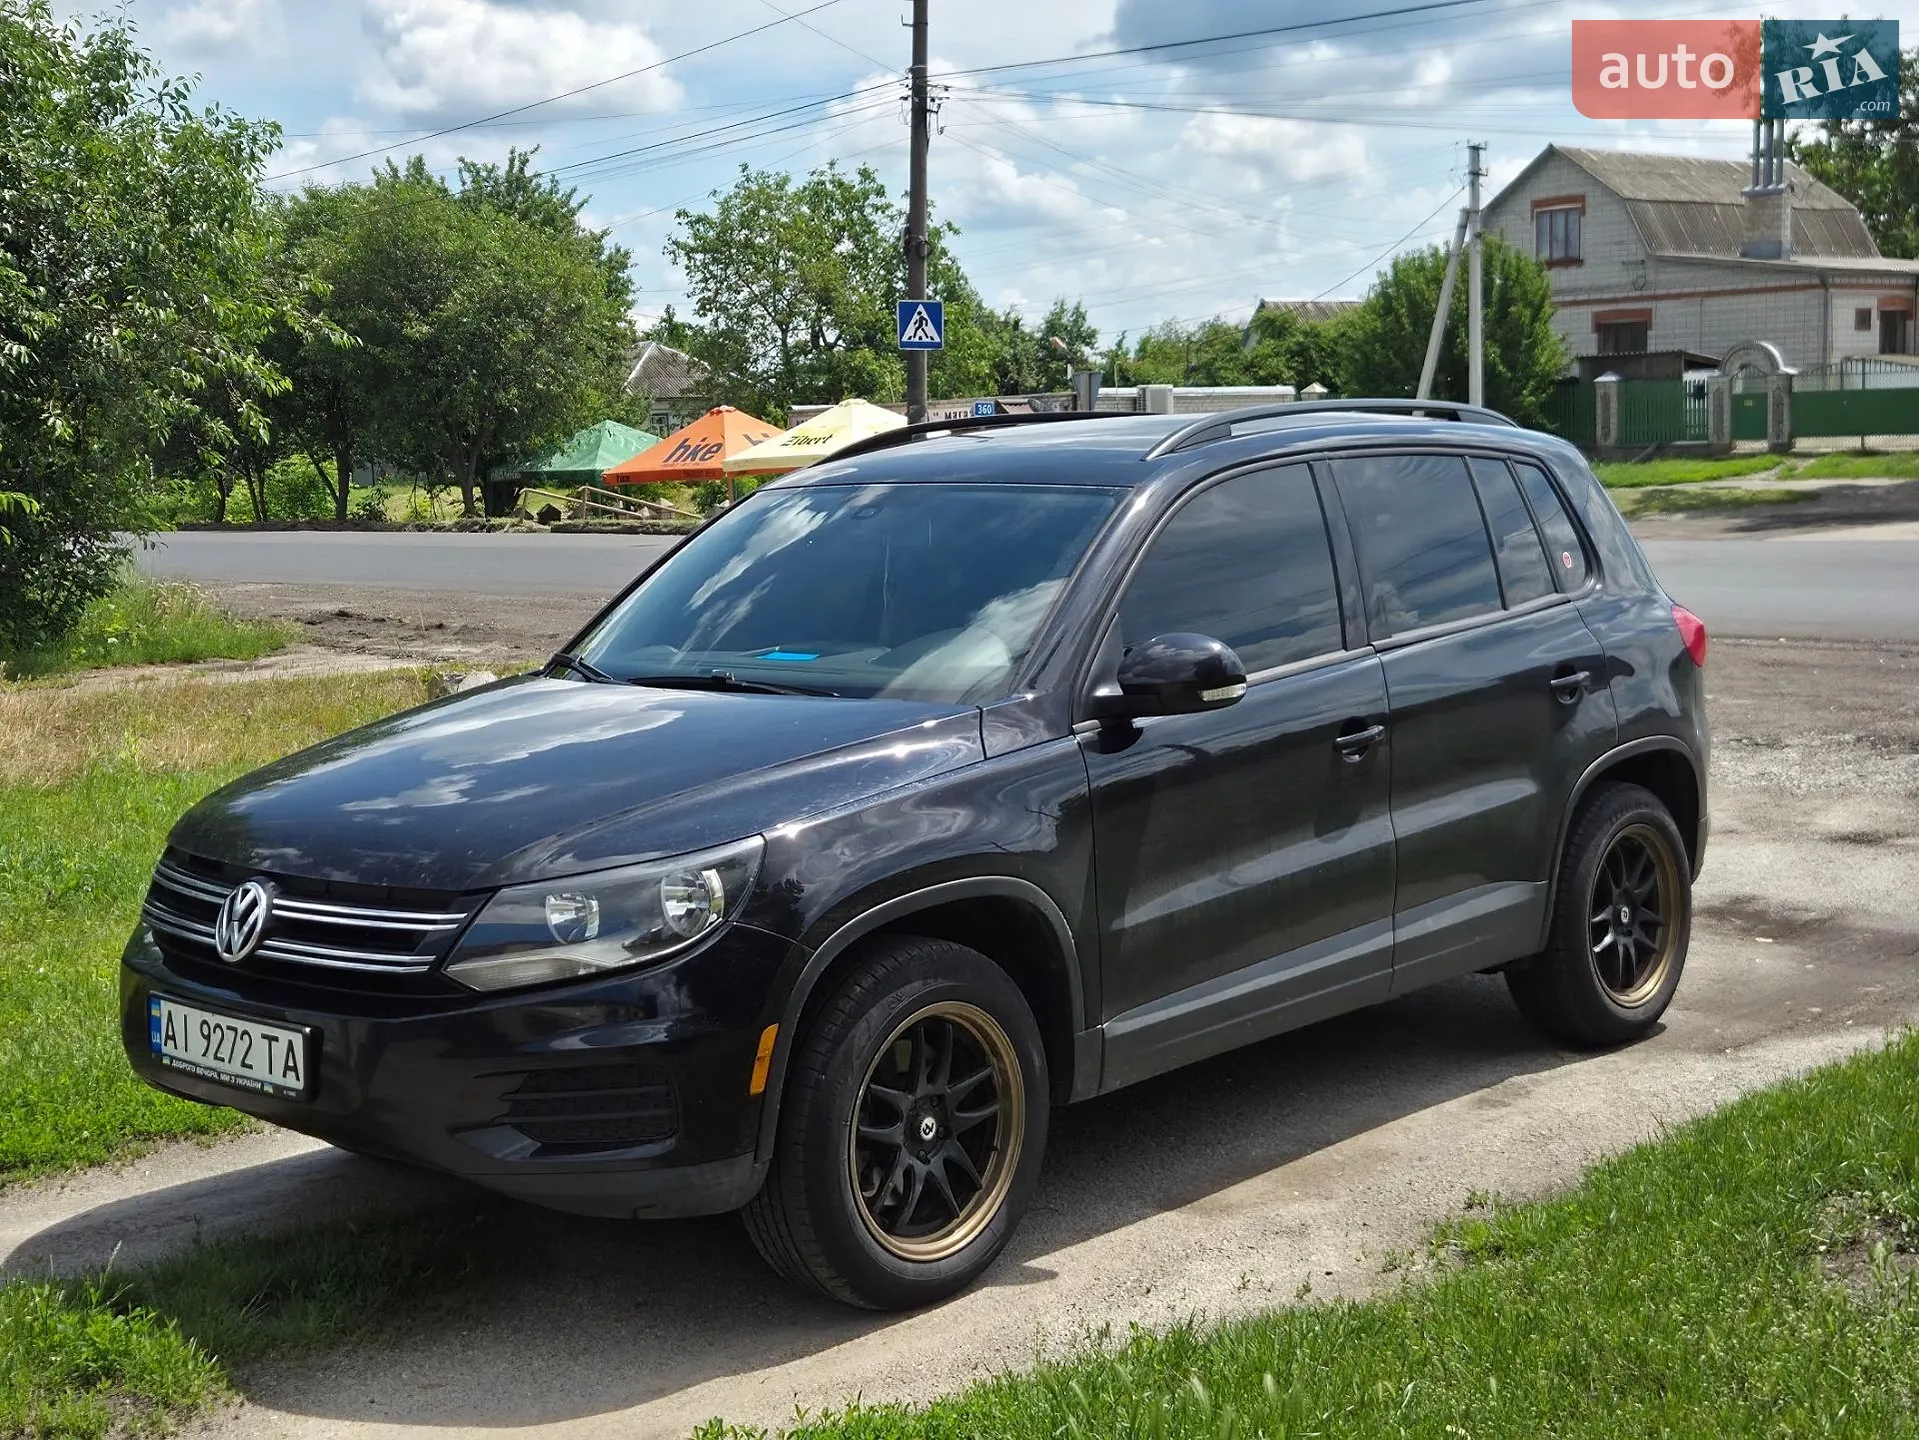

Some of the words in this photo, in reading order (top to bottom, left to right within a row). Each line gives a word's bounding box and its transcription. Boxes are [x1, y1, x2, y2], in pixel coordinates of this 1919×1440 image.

[977, 404, 992, 414] 360
[780, 433, 833, 447] Zibert
[663, 437, 723, 463] hike
[151, 1031, 161, 1044] UA
[163, 1009, 189, 1053] AI
[199, 1018, 254, 1071] 9272
[260, 1032, 301, 1082] TA
[172, 1060, 195, 1072] ДОБРОГО
